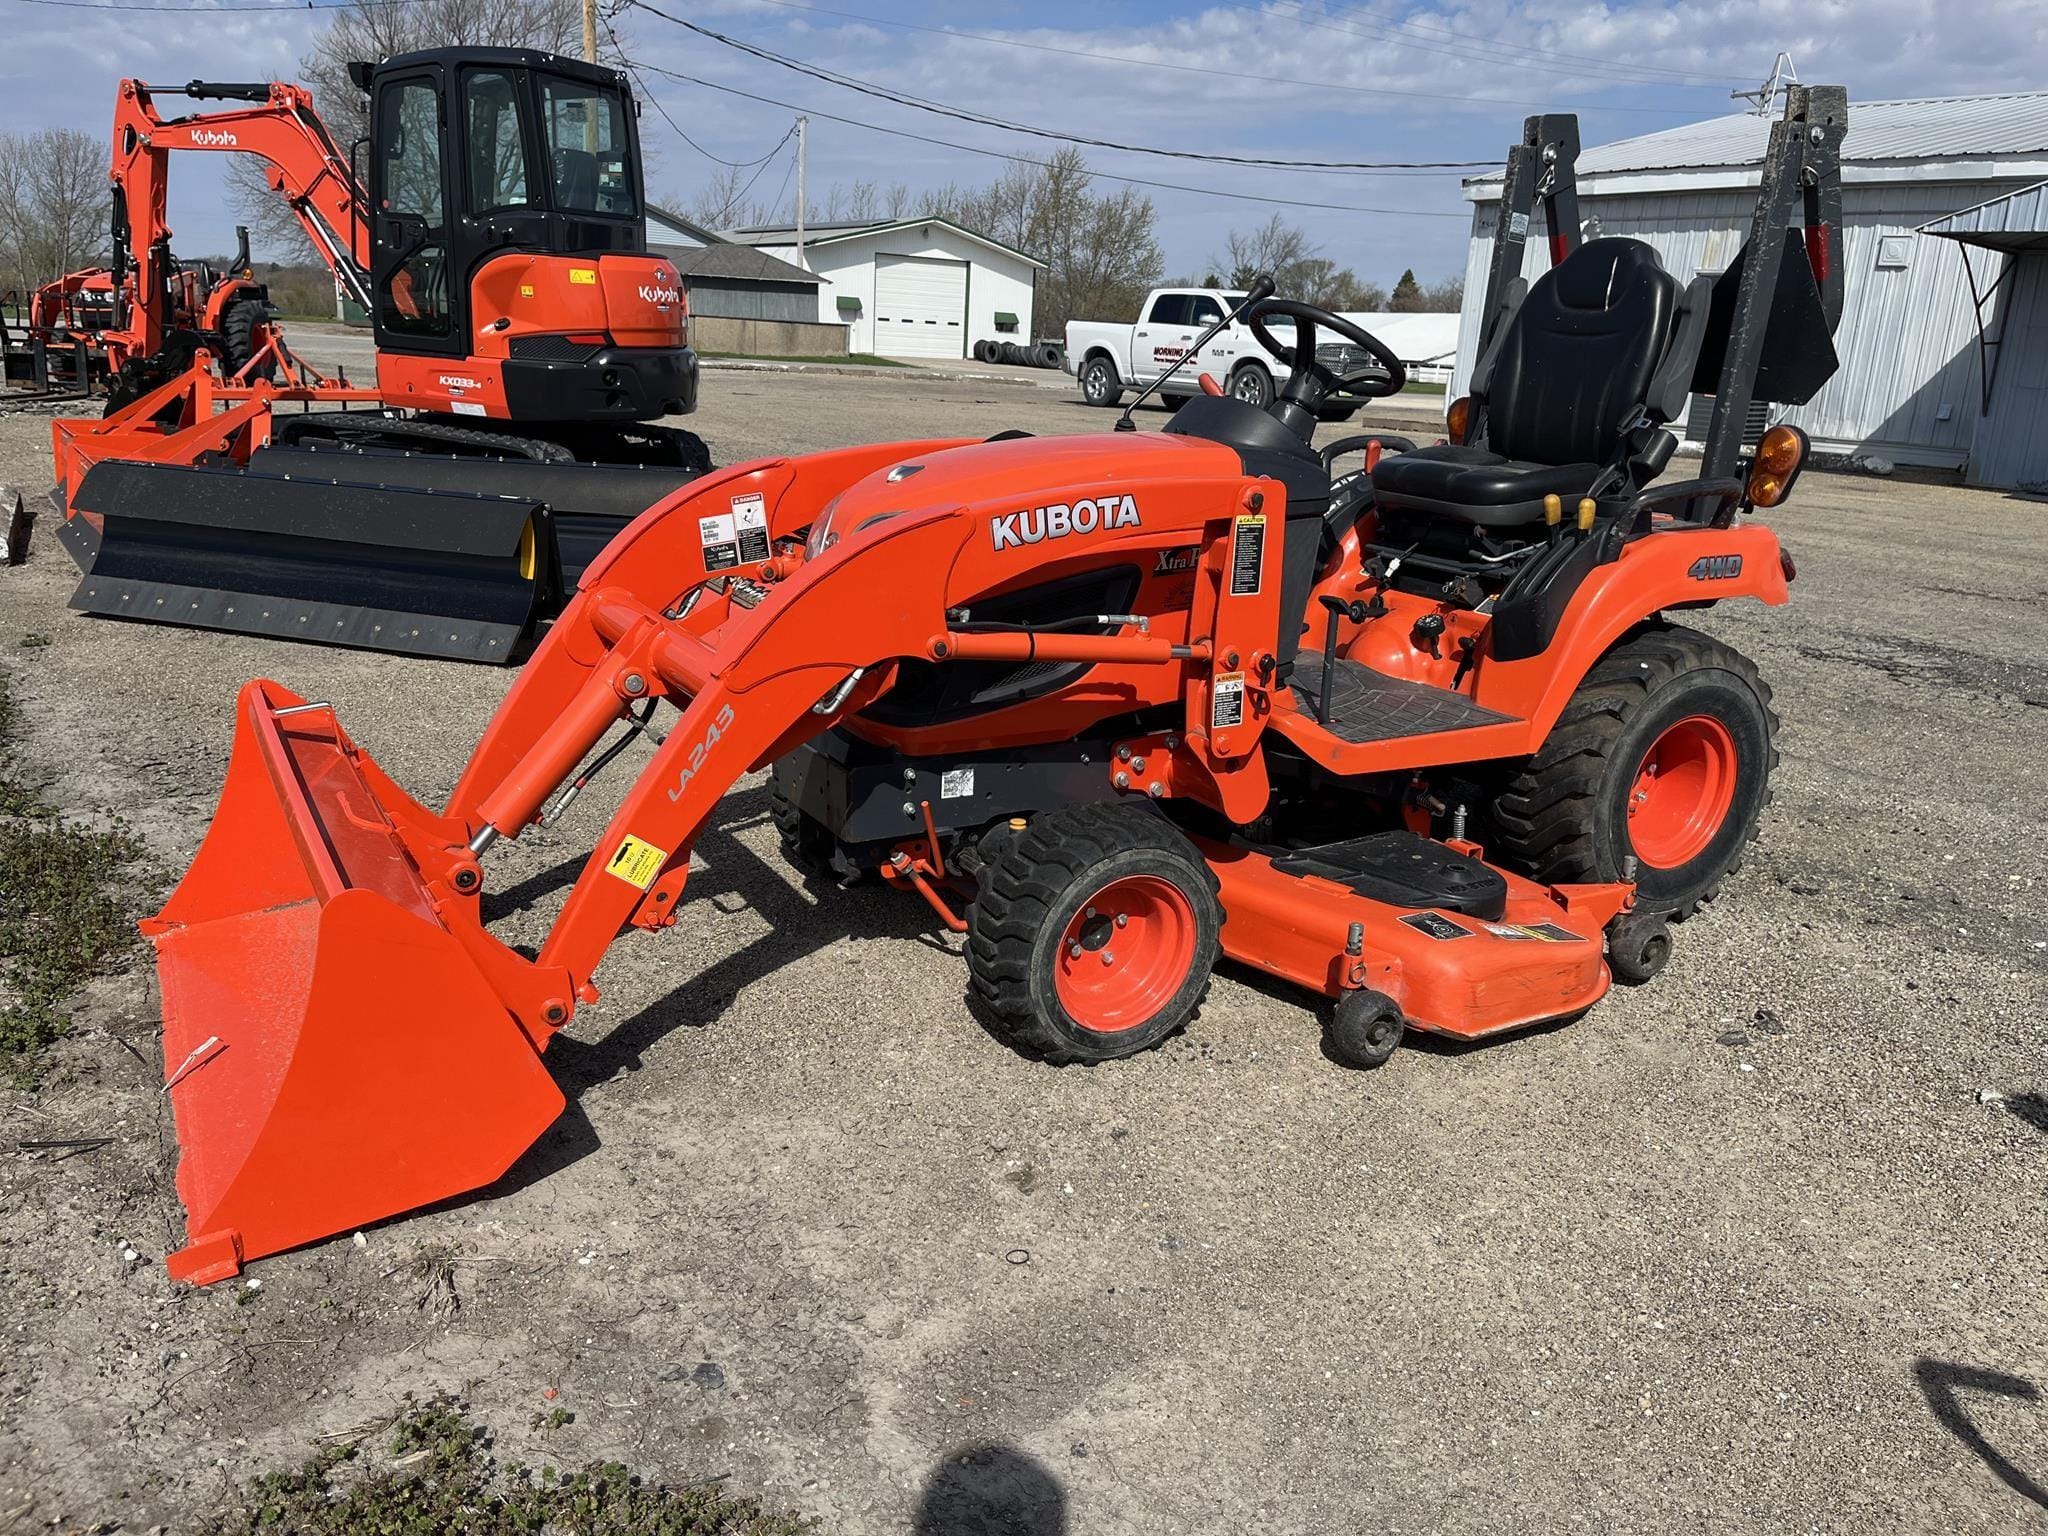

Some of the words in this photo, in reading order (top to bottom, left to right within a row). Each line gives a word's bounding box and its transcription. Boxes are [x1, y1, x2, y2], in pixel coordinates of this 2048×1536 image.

[191, 129, 237, 146] Kubota
[638, 285, 680, 303] Kubota
[1153, 347, 1183, 357] MORNING
[439, 375, 482, 389] KX033-4
[990, 493, 1142, 552] KUBOTA
[1154, 550, 1187, 571] Xtra
[1687, 554, 1743, 581] 4WD
[667, 703, 735, 802] LA243
[627, 847, 650, 878] LUBRICATE
